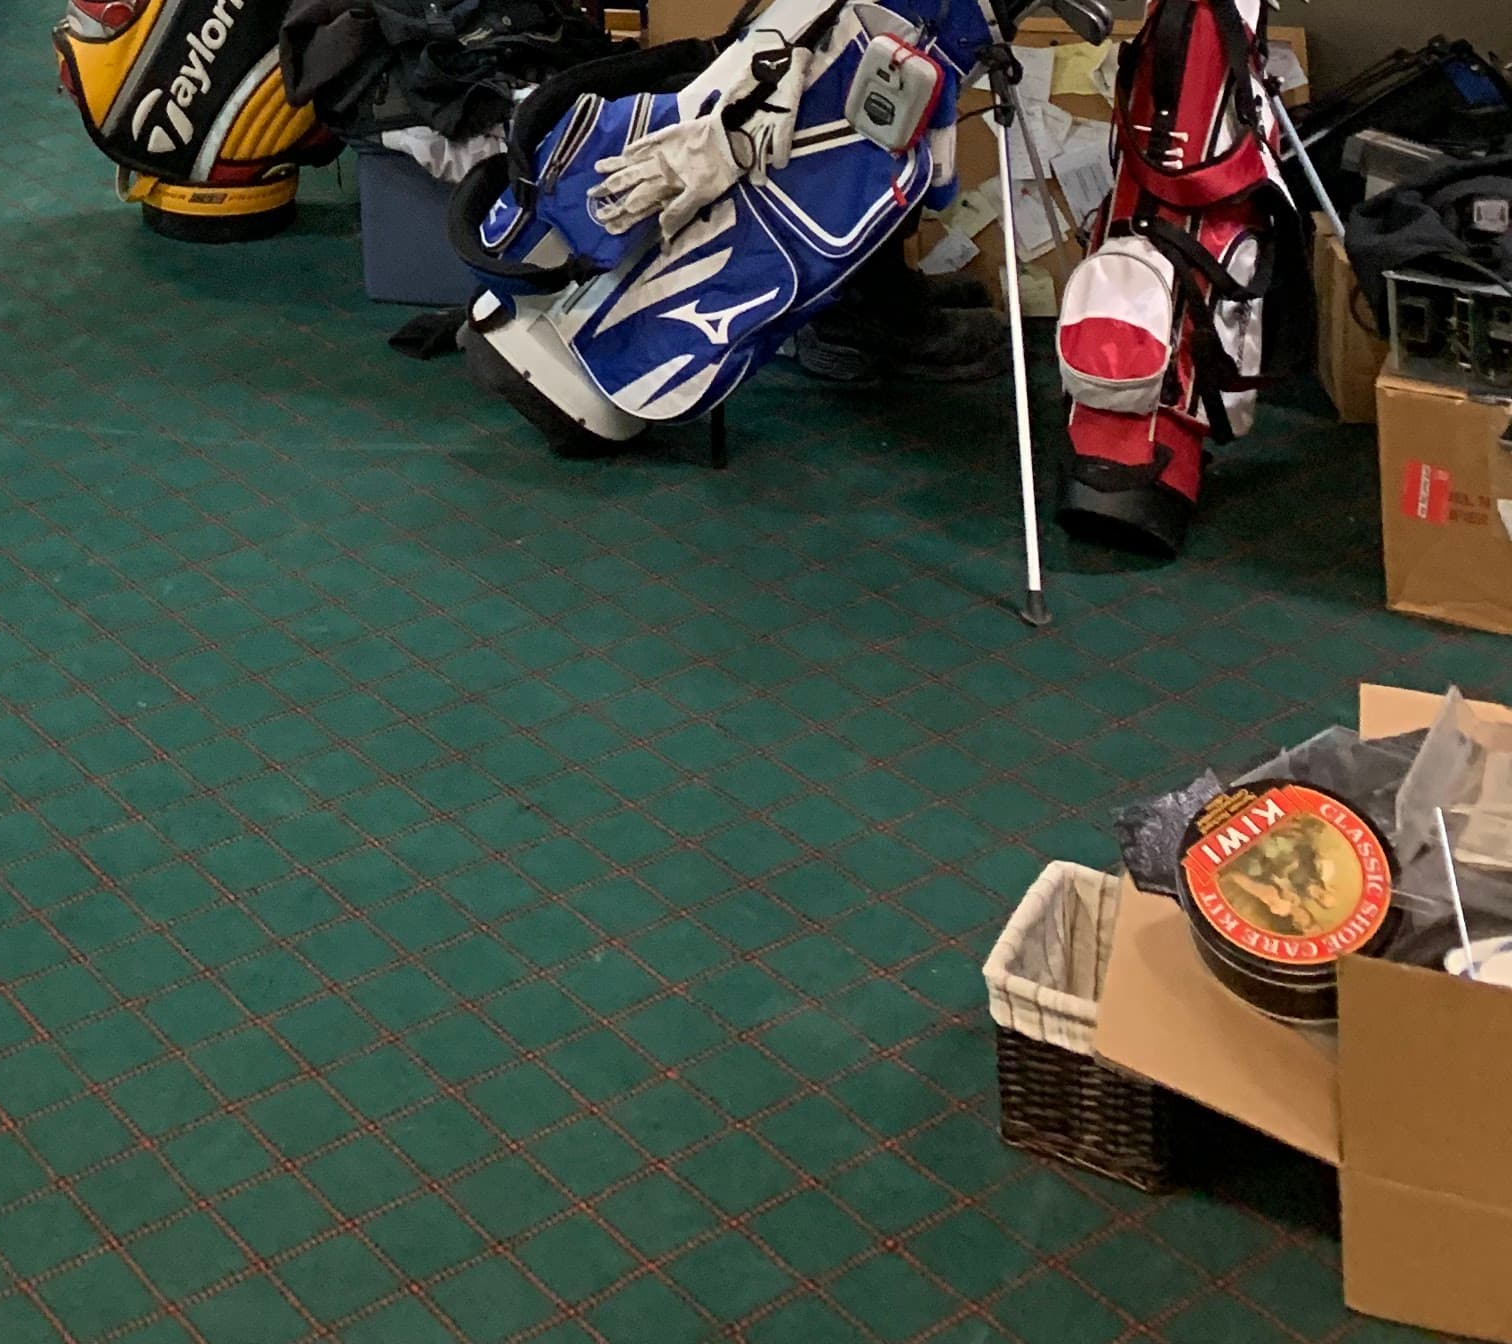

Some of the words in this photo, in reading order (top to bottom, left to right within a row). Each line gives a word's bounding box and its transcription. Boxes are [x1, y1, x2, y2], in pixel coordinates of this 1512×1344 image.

[1200, 797, 1287, 866] KIWI
[1319, 802, 1385, 898] CLASSIC
[1200, 890, 1241, 931] KIT
[1323, 902, 1379, 954] SHOE
[1241, 929, 1320, 959] CARE
